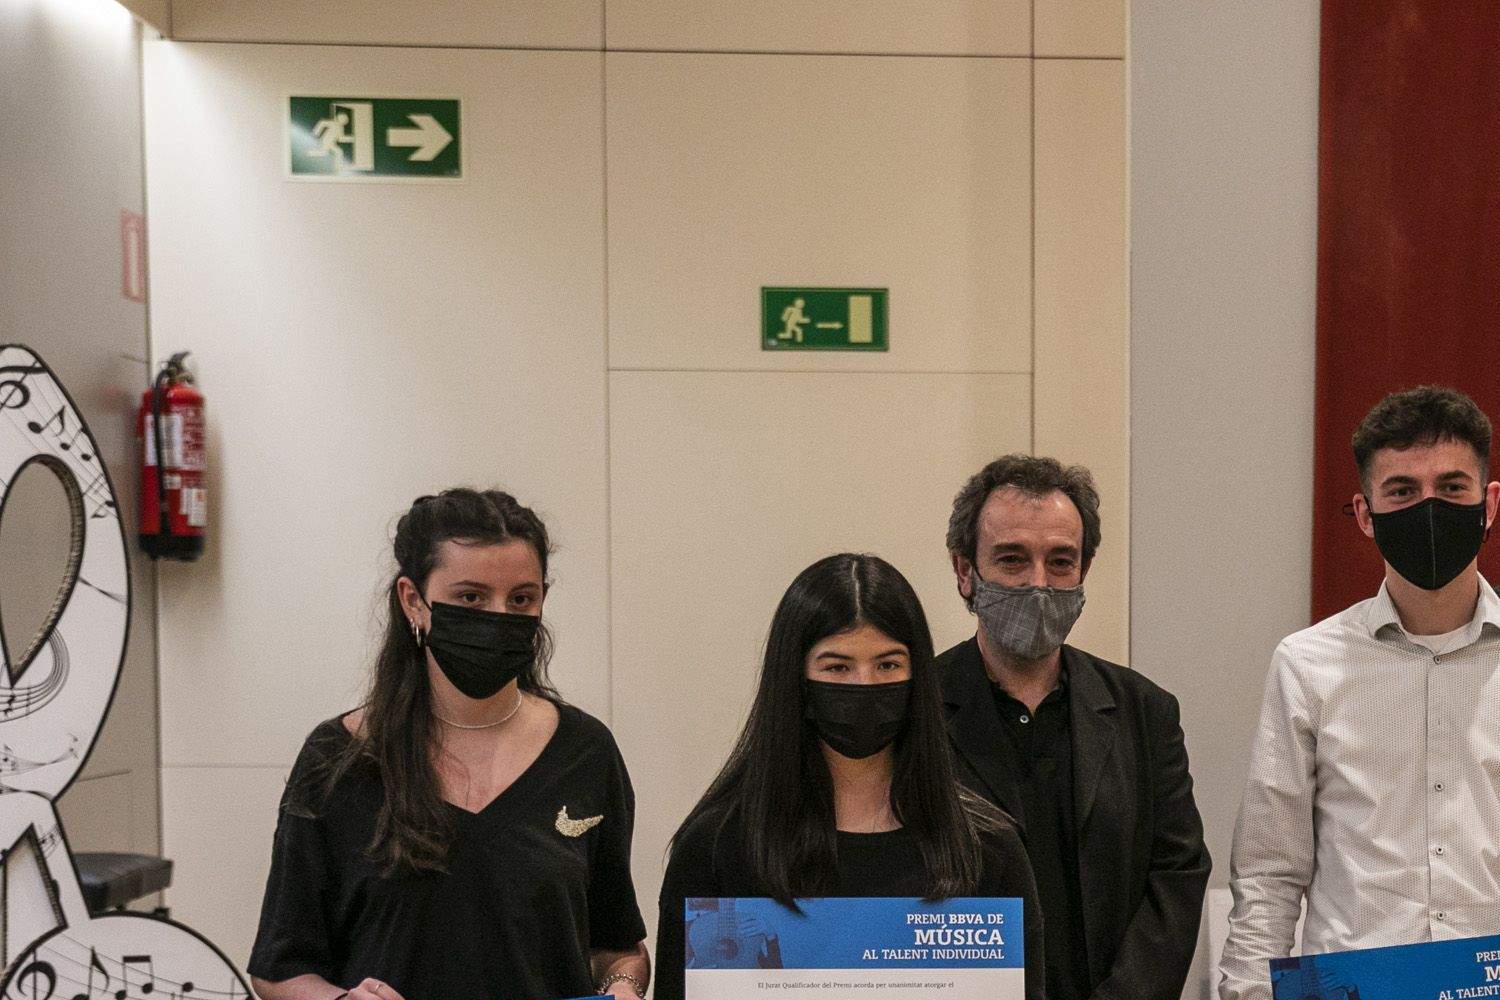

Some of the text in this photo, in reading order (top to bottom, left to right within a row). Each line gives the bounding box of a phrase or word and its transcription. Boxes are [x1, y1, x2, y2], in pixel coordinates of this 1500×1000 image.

[906, 913, 1004, 925] PREMI BBVA DE
[914, 924, 1004, 945] MÚSICA
[862, 948, 1004, 960] AL TALENT INDIVIDUAL
[1455, 984, 1500, 999] TALENT
